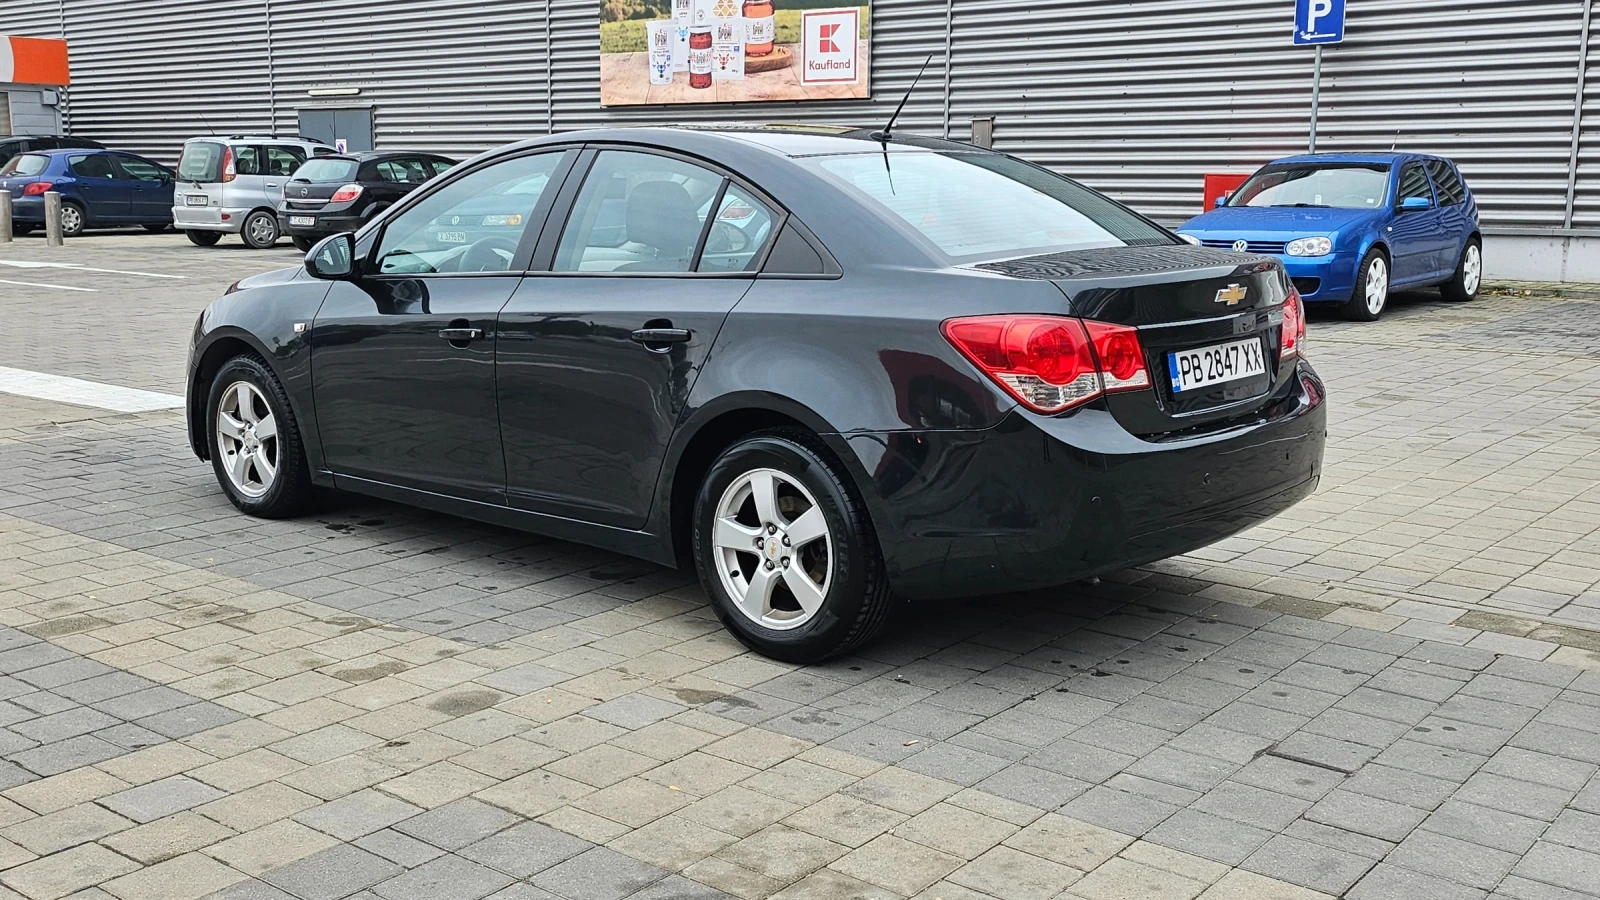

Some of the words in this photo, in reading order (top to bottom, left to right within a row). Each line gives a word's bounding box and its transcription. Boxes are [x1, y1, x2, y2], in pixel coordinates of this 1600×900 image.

[1307, 0, 1332, 32] P
[809, 58, 851, 70] Kaufland
[1180, 353, 1203, 386] PB
[1205, 346, 1239, 381] 2847
[1241, 341, 1262, 373] XX
[1171, 377, 1180, 387] BG
